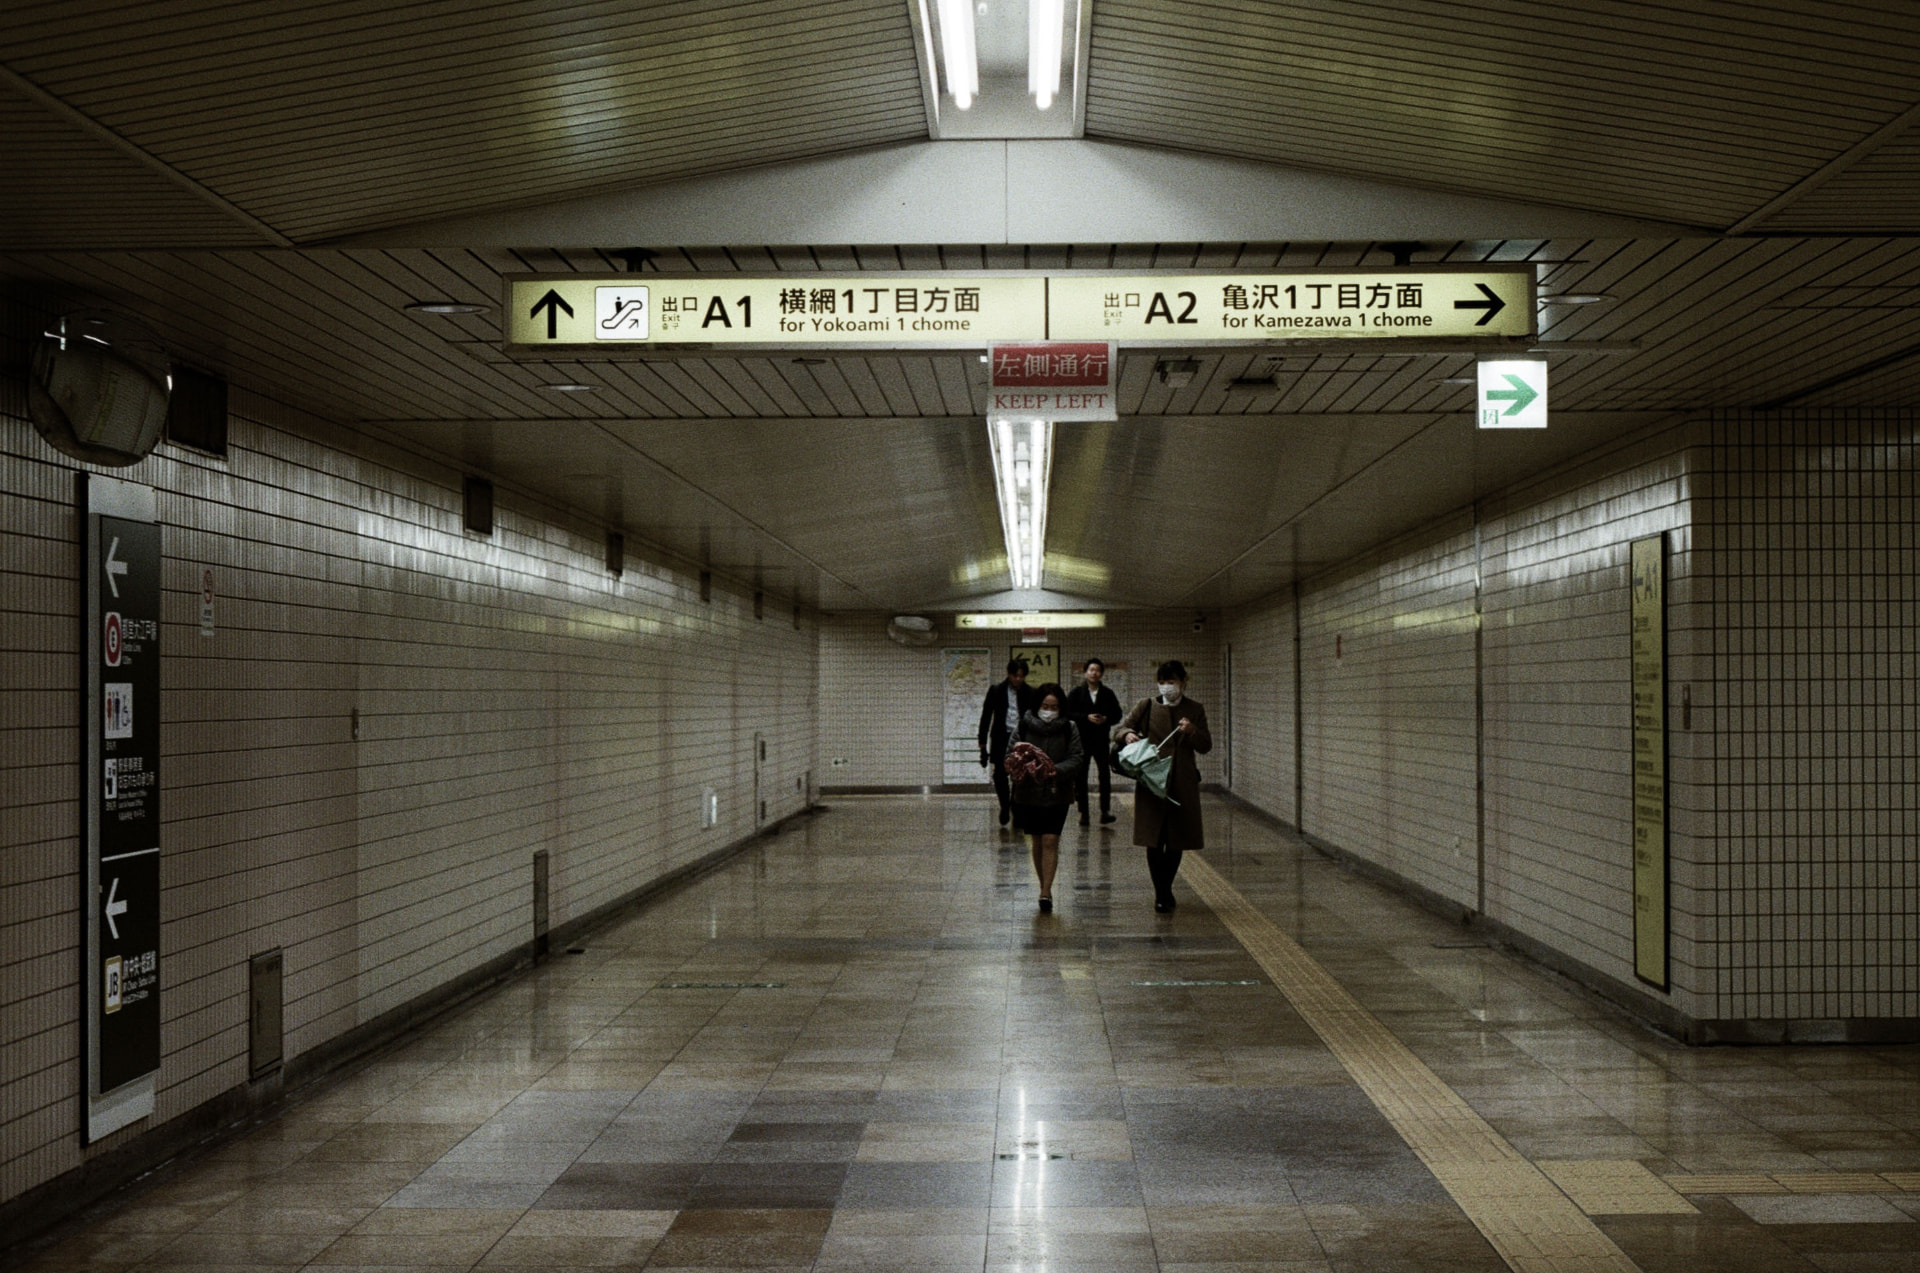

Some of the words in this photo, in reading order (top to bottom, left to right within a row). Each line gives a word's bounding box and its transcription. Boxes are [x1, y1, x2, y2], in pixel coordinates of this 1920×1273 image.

[662, 295, 698, 312] 出口
[779, 287, 981, 314] 横網1丁目方面
[1104, 293, 1140, 308] 出口
[1222, 282, 1424, 310] 亀沢1丁目方面
[701, 295, 753, 329] A1
[1103, 310, 1123, 318] Exit
[1144, 291, 1198, 324] A2
[661, 313, 681, 322] Exit
[779, 316, 806, 332] for
[811, 316, 890, 332] Yokoami
[897, 317, 904, 331] 1
[912, 316, 971, 332] chome
[1222, 313, 1249, 328] for
[1254, 313, 1352, 328] Kamezawa
[1358, 313, 1366, 327] 1
[1373, 312, 1433, 327] chome
[994, 353, 1108, 378] 左側通行
[994, 394, 1049, 409] KEEP
[1055, 393, 1109, 409] LEFT
[1644, 560, 1657, 599] A1
[1032, 653, 1051, 666] A1
[108, 972, 118, 998] JB
